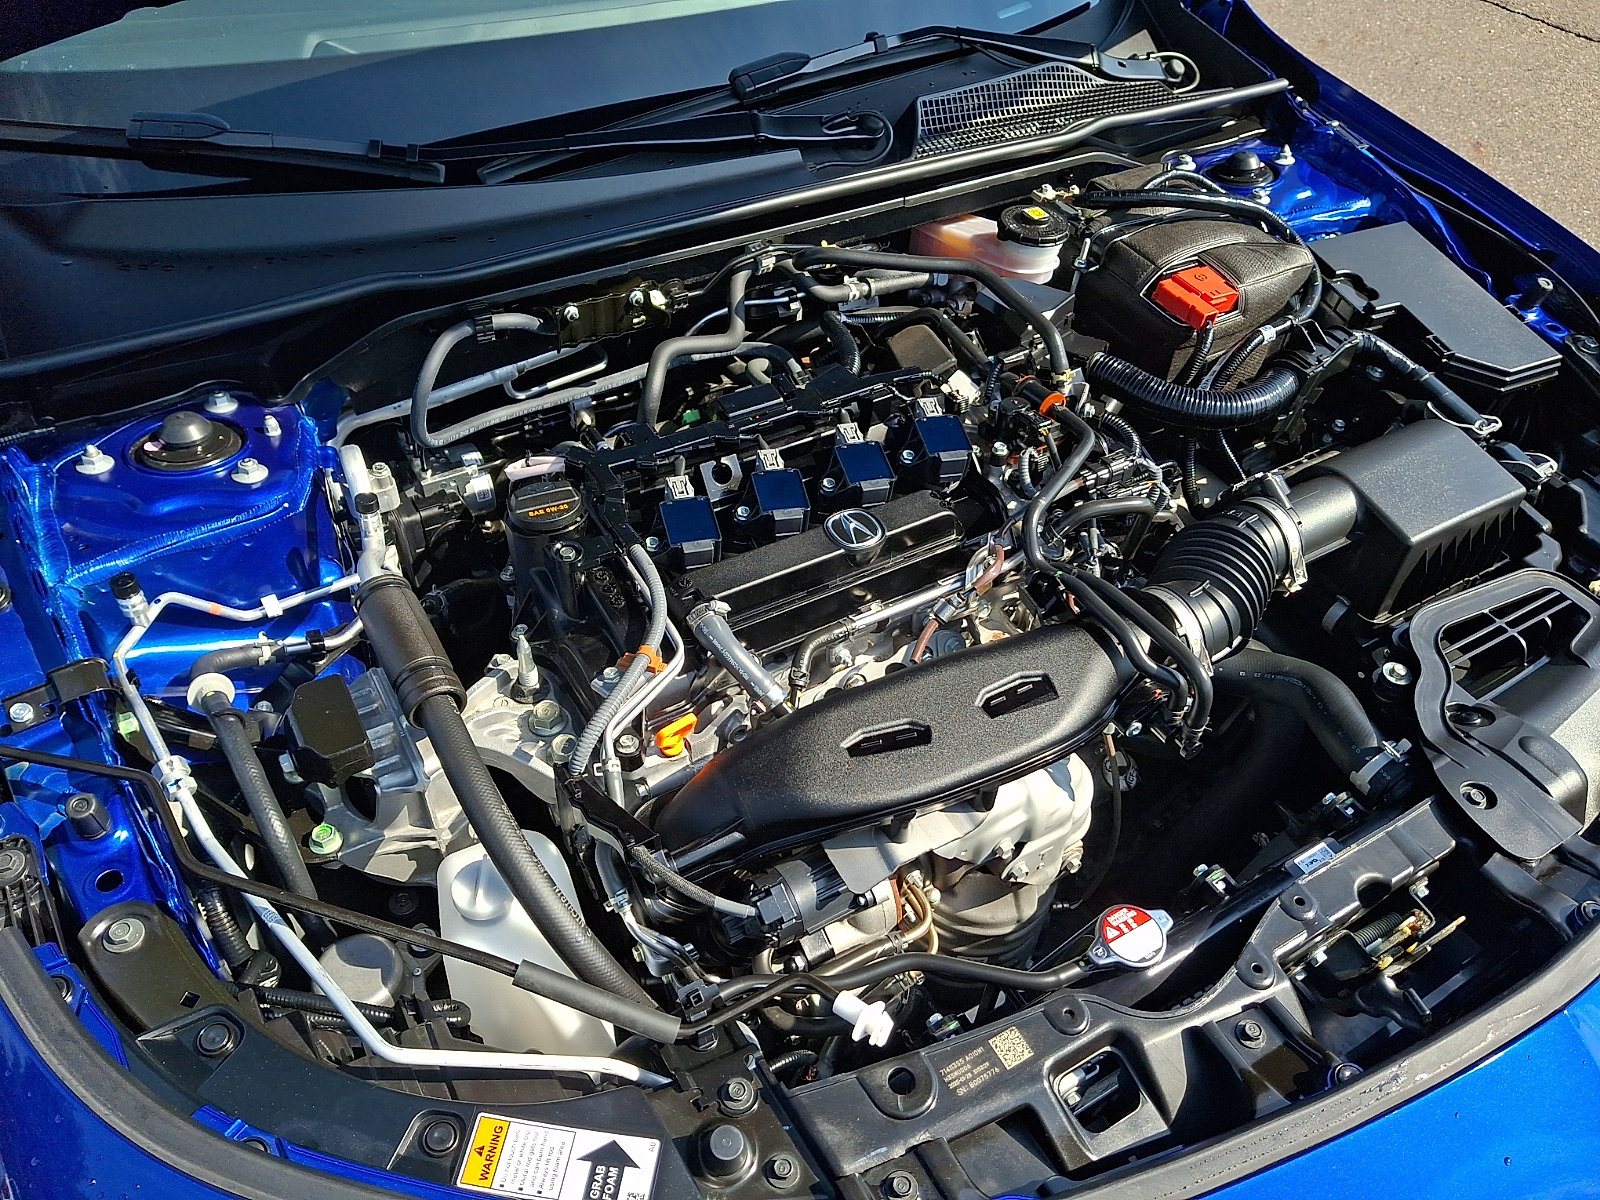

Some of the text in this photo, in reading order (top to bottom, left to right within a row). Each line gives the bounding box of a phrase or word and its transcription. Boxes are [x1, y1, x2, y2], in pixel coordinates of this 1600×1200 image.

[546, 504, 568, 512] 0W-20
[479, 1125, 504, 1181] WARNING
[590, 1166, 604, 1200] GRAB
[603, 1166, 620, 1200] FOAM
